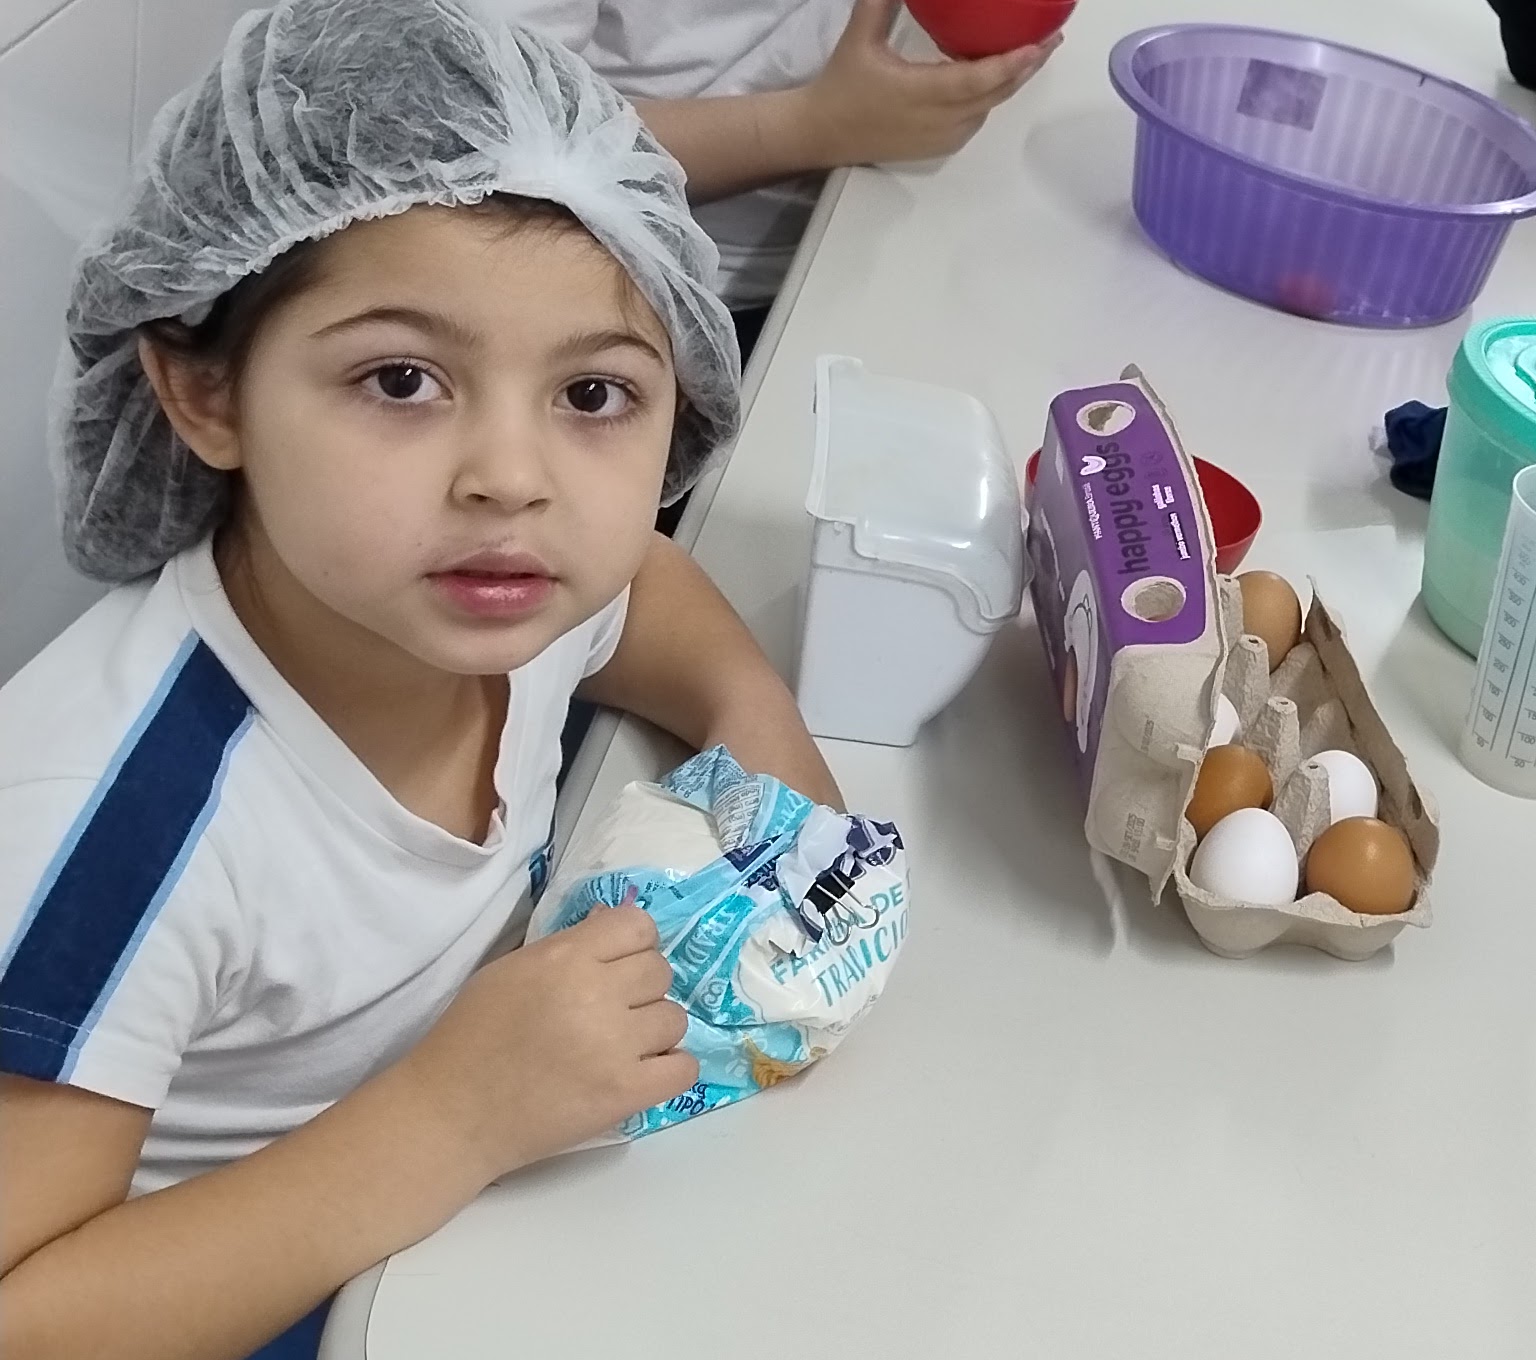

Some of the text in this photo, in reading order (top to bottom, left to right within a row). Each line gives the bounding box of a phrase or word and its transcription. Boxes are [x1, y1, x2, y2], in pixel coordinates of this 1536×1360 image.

[1096, 441, 1152, 575] happy eggs
[1521, 735, 1536, 745] 100
[1514, 759, 1525, 768] 50
[870, 881, 904, 914] DE
